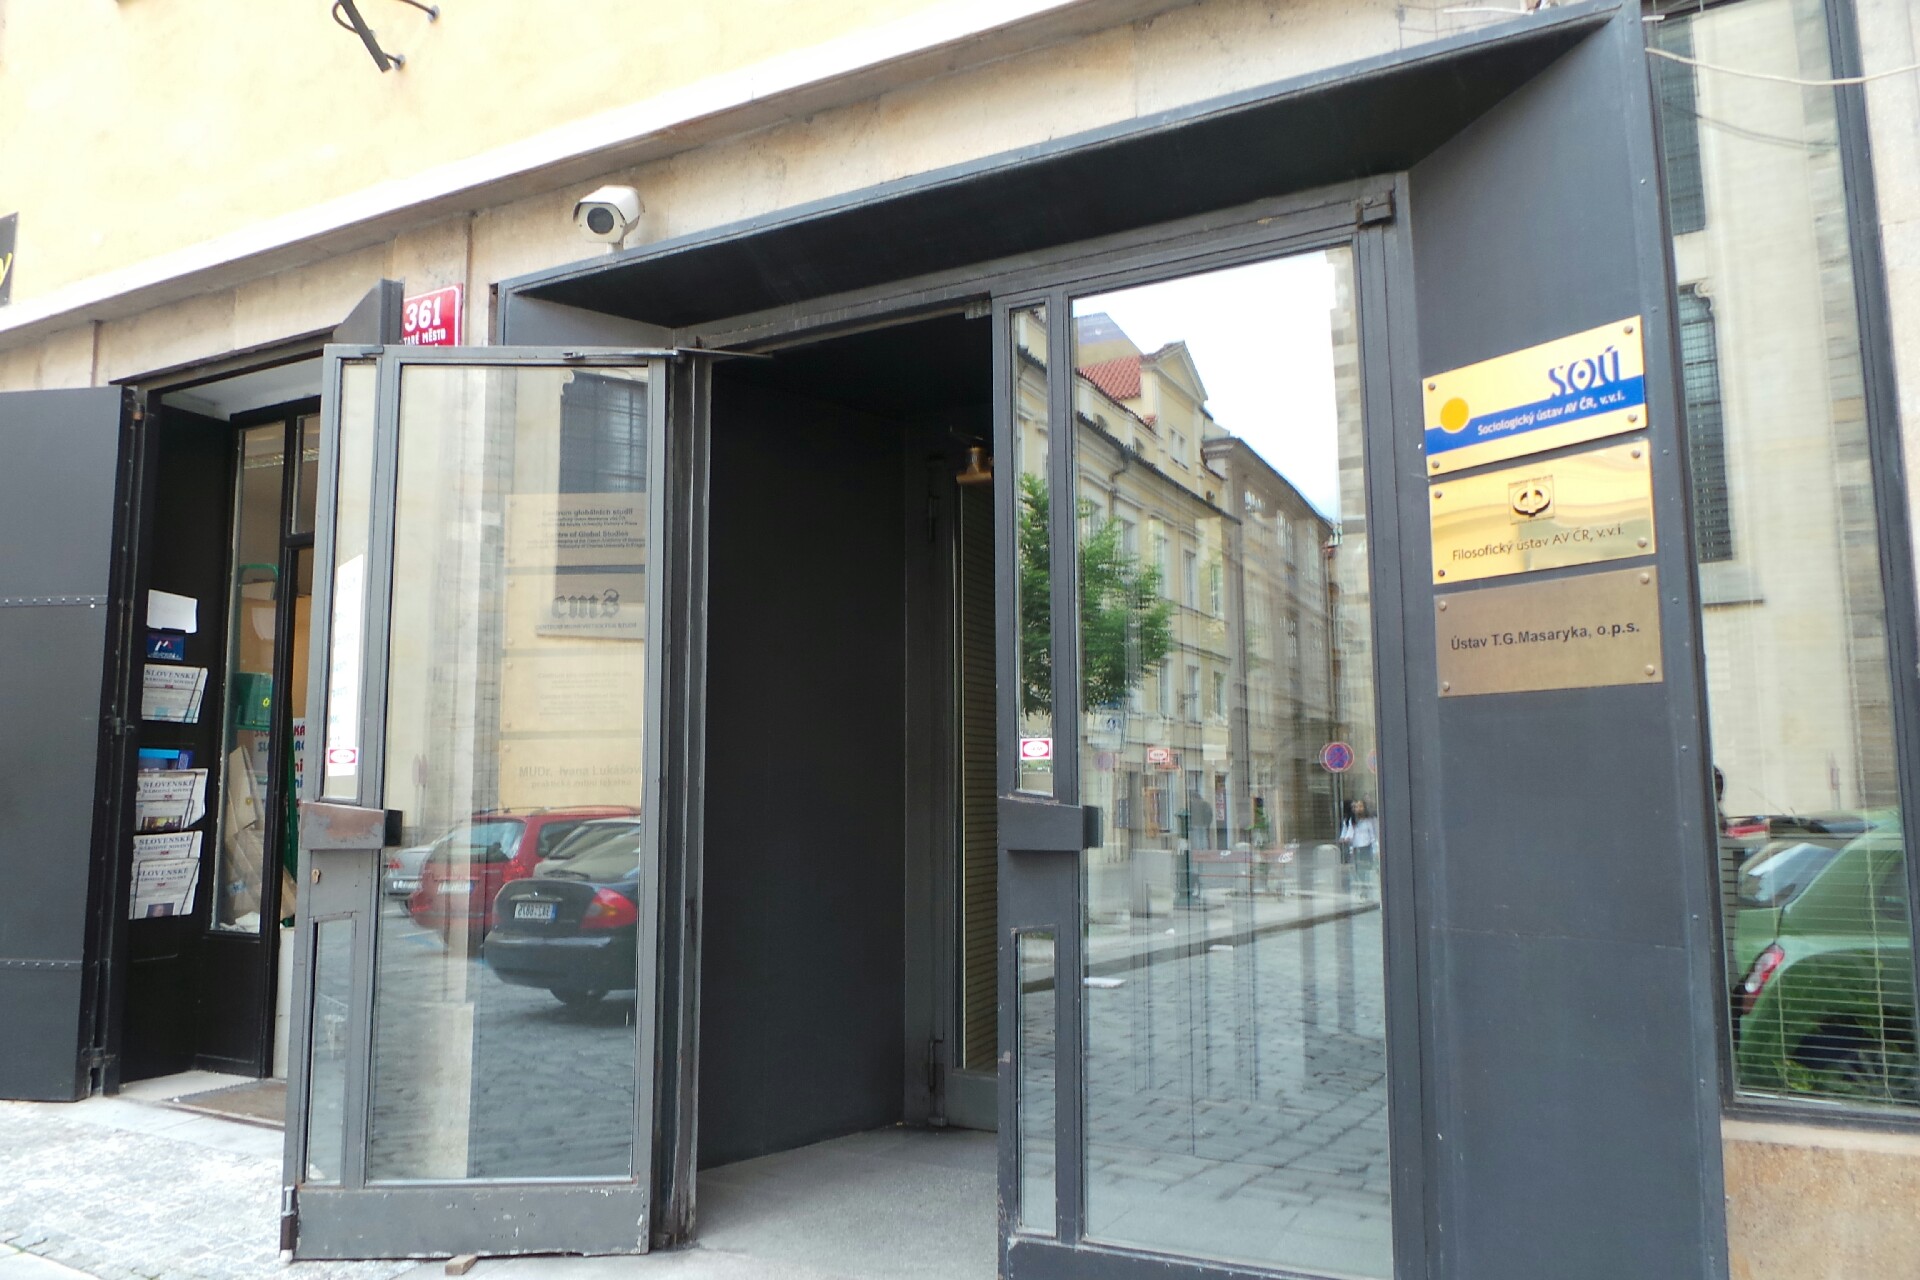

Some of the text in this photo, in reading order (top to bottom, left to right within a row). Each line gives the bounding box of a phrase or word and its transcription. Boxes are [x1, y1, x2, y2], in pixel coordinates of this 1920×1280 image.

[404, 296, 441, 332] 361
[403, 331, 420, 346] TARÉ
[1547, 345, 1621, 398] SOÚ
[1478, 411, 1534, 436] Sociologický
[1536, 406, 1564, 422] ústav
[1564, 402, 1578, 415] AV
[1579, 397, 1598, 411] ČR,
[1452, 540, 1513, 561] Filosofický
[1516, 535, 1549, 551] ústav
[1552, 532, 1569, 545] AV
[1573, 529, 1594, 543] ČR,
[1451, 634, 1488, 651] Ústav
[1596, 621, 1640, 638] o.p.s.
[519, 763, 641, 777] MUDr. Ivana Lukášov
